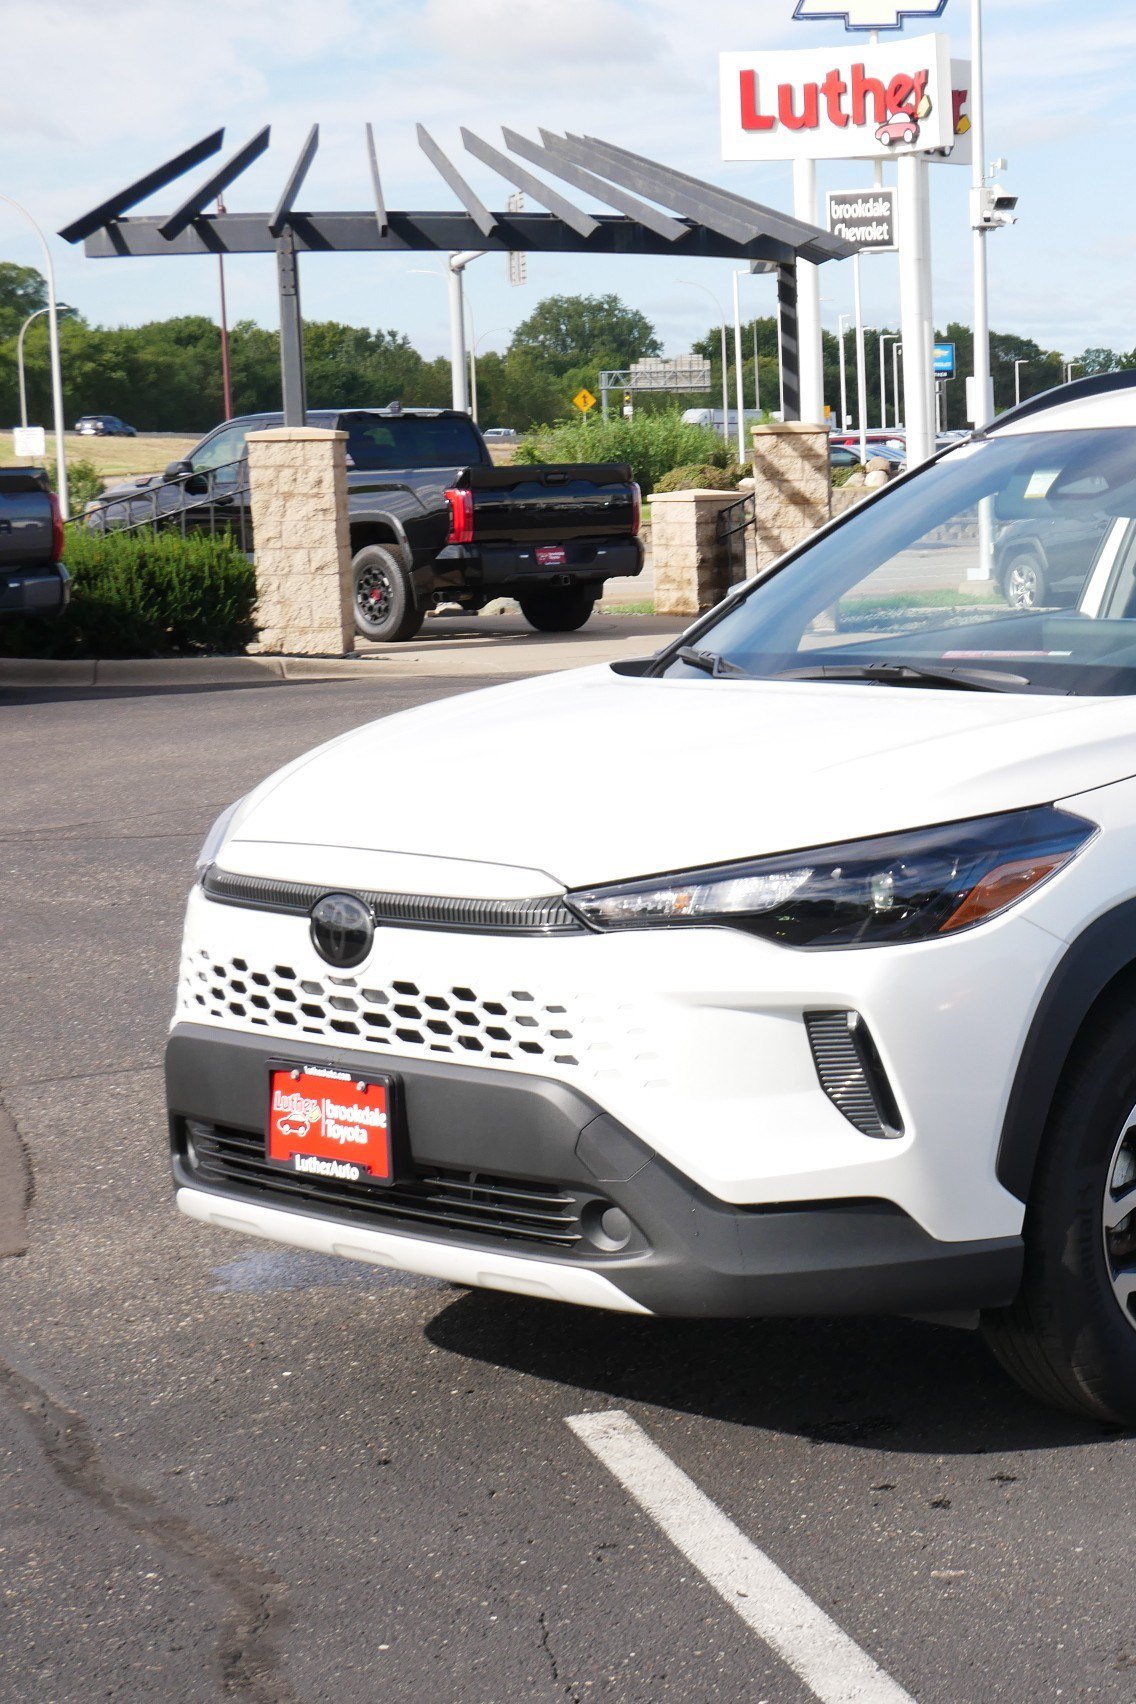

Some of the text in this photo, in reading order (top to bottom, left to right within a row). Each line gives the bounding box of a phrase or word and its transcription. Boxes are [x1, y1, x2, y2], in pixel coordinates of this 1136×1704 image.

[739, 63, 929, 130] Luther
[831, 197, 890, 219] brookdale
[834, 221, 889, 241] Chevrolet
[325, 1098, 387, 1129] brookdale
[325, 1118, 368, 1145] Toyota
